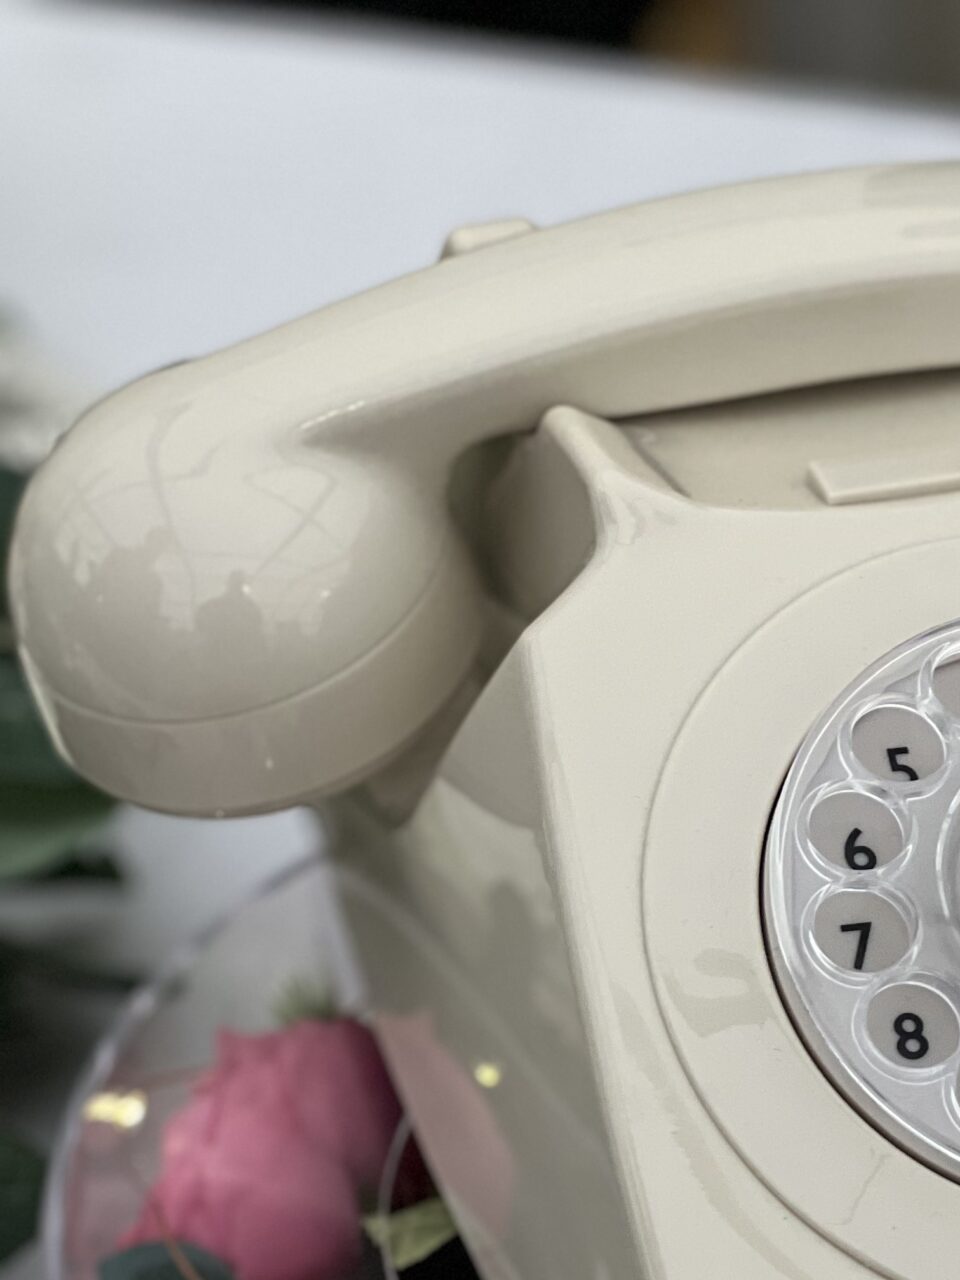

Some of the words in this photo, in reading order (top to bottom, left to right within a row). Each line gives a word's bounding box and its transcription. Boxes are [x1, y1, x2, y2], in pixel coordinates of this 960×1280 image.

[886, 746, 920, 782] 5
[844, 827, 878, 871] 6
[839, 921, 872, 971] 7
[893, 1012, 930, 1061] 8
